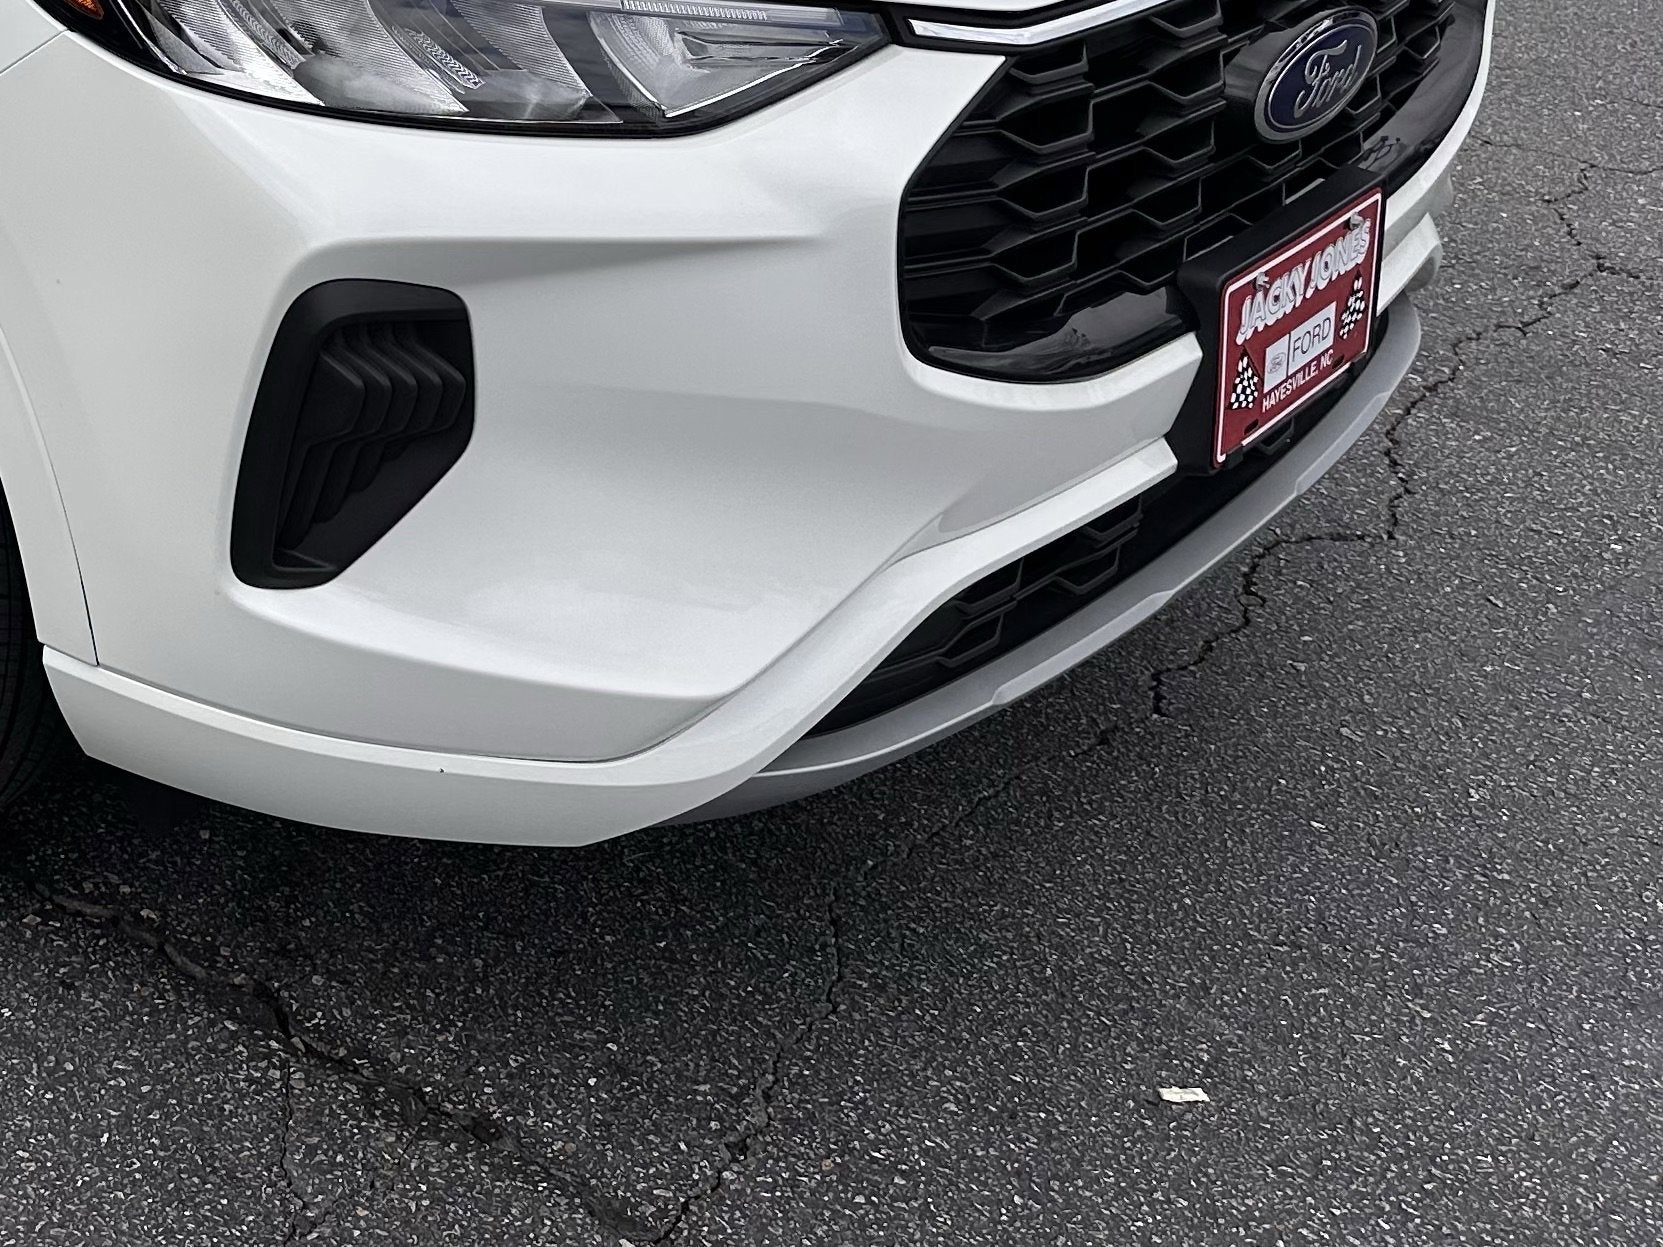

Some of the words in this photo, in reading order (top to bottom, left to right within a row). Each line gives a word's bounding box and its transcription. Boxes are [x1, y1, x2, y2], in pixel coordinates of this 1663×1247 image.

[1293, 39, 1362, 119] Ford
[1236, 257, 1312, 346] JACKY
[1305, 217, 1371, 299] JONES
[1292, 316, 1332, 363] FORD
[1320, 348, 1335, 371] NC
